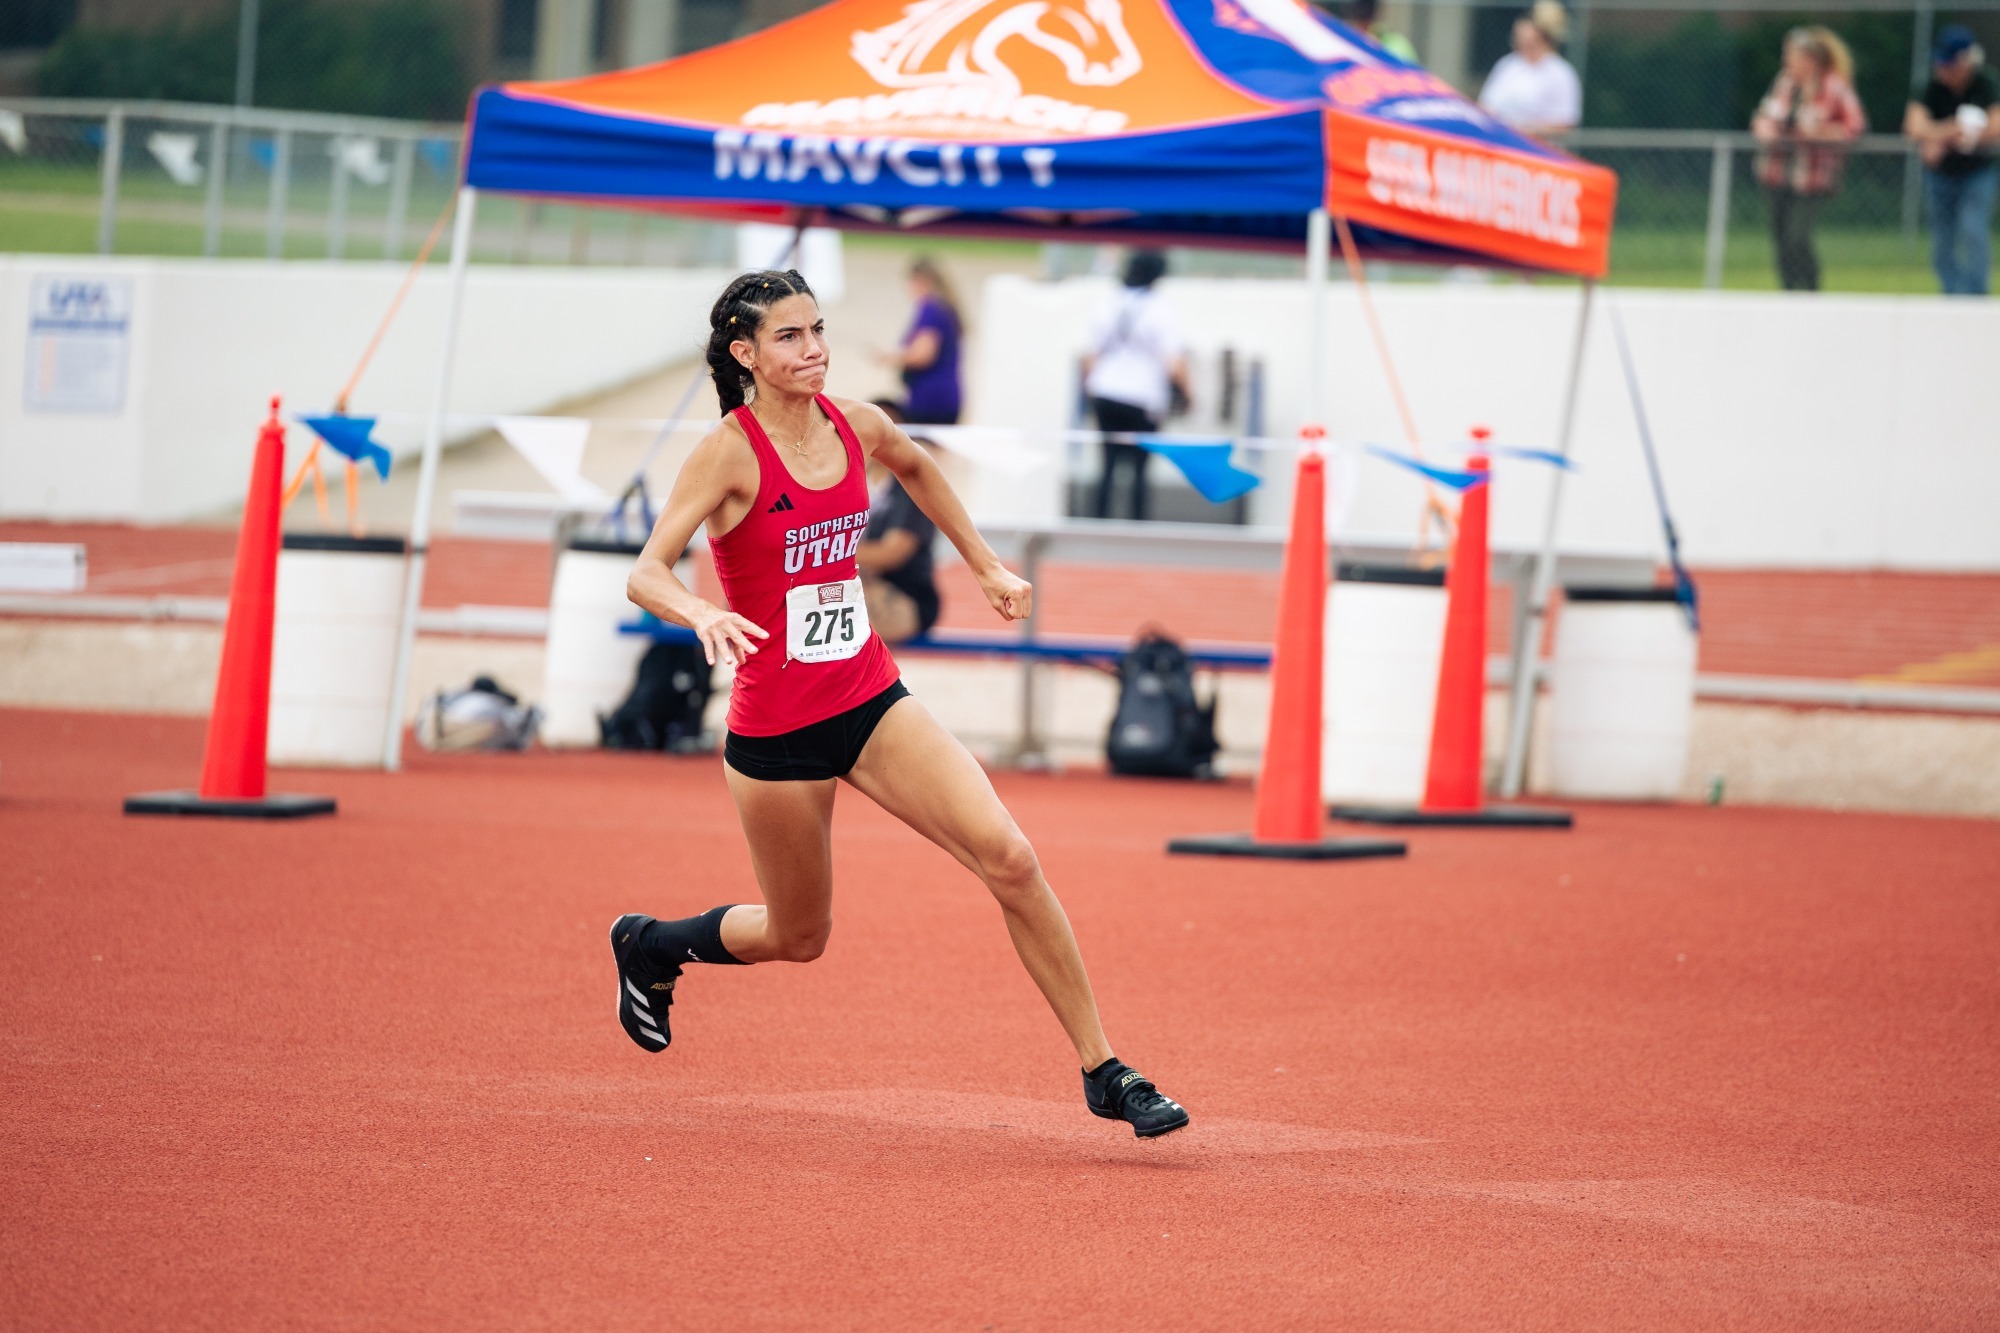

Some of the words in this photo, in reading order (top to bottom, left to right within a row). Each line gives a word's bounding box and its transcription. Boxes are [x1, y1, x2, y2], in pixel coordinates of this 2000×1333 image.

[785, 508, 870, 546] SOUTHERN
[784, 526, 866, 574] UTAH
[804, 607, 854, 647] 275
